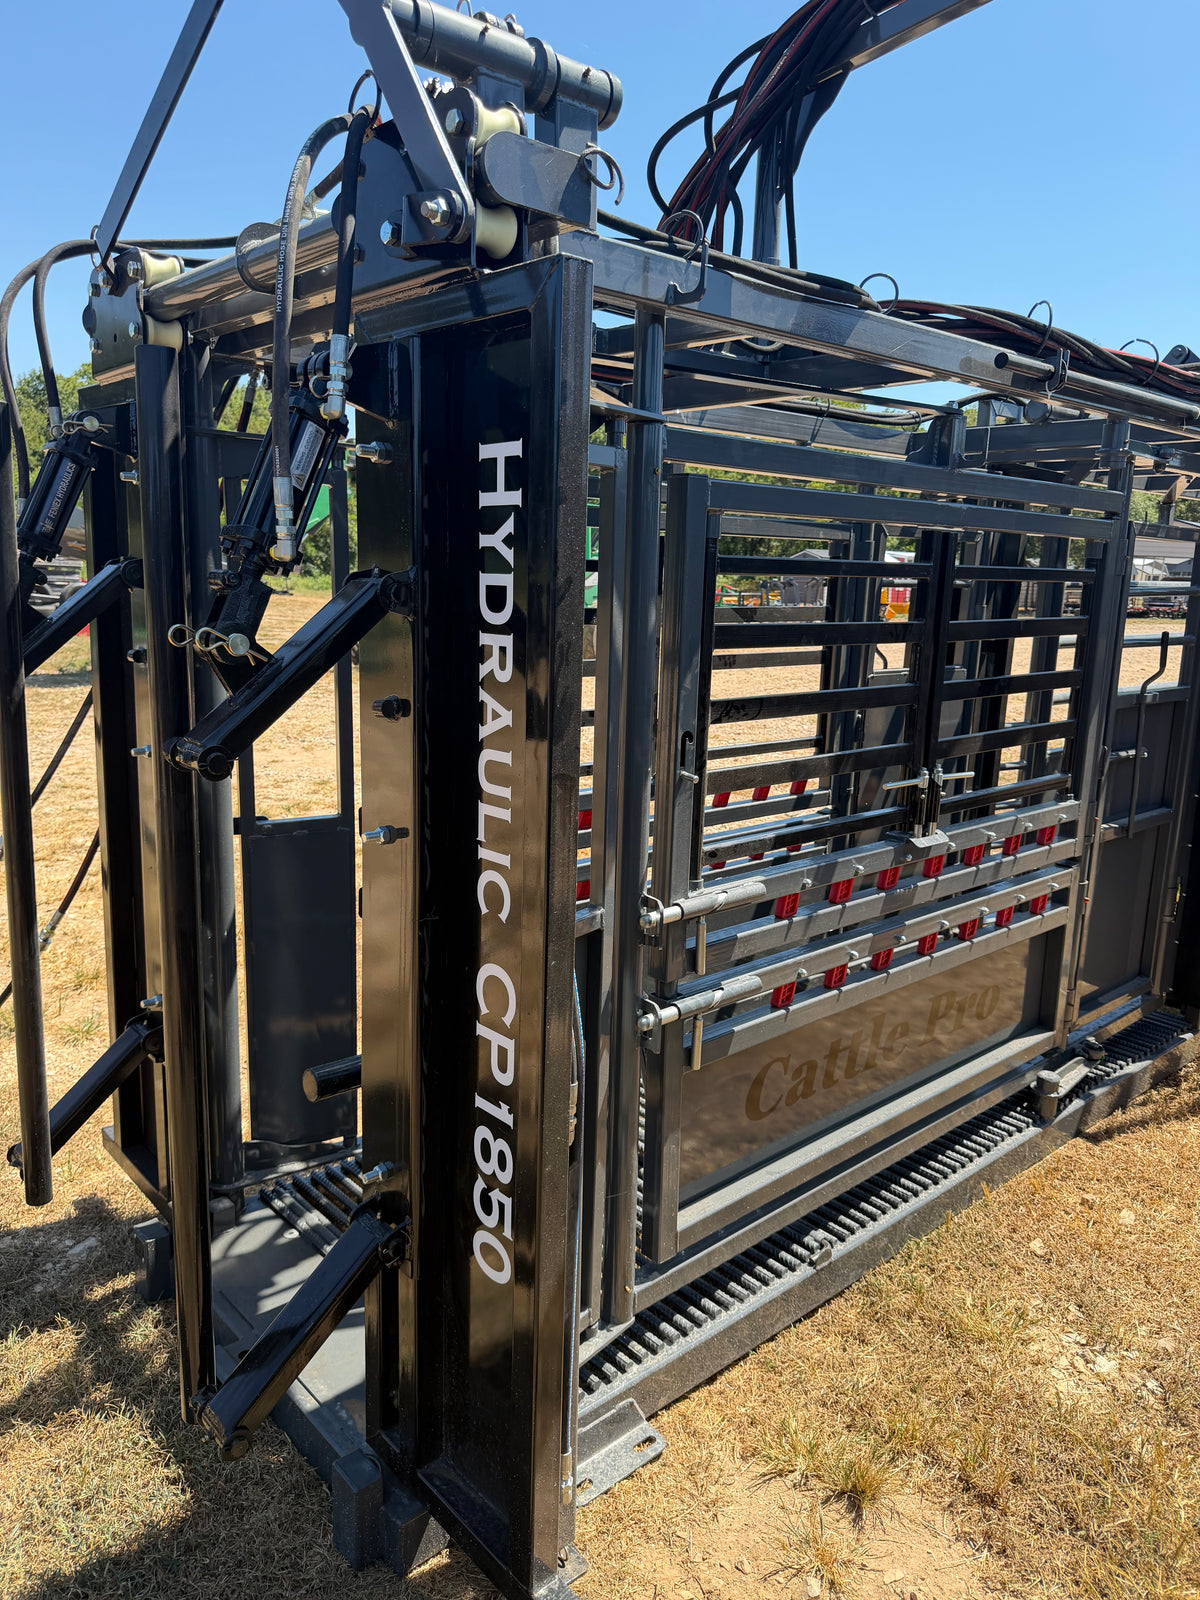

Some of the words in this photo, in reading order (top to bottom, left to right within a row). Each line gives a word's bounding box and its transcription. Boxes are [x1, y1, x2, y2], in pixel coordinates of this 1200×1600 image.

[276, 264, 284, 312] HYDRAULIC
[279, 240, 287, 262] HOSE
[56, 462, 76, 499] HYDRAULICS
[476, 437, 522, 923] HYDRAULIC
[745, 1012, 910, 1122] Cattle
[919, 985, 1001, 1046] Pro
[472, 963, 517, 1285] CP1850
